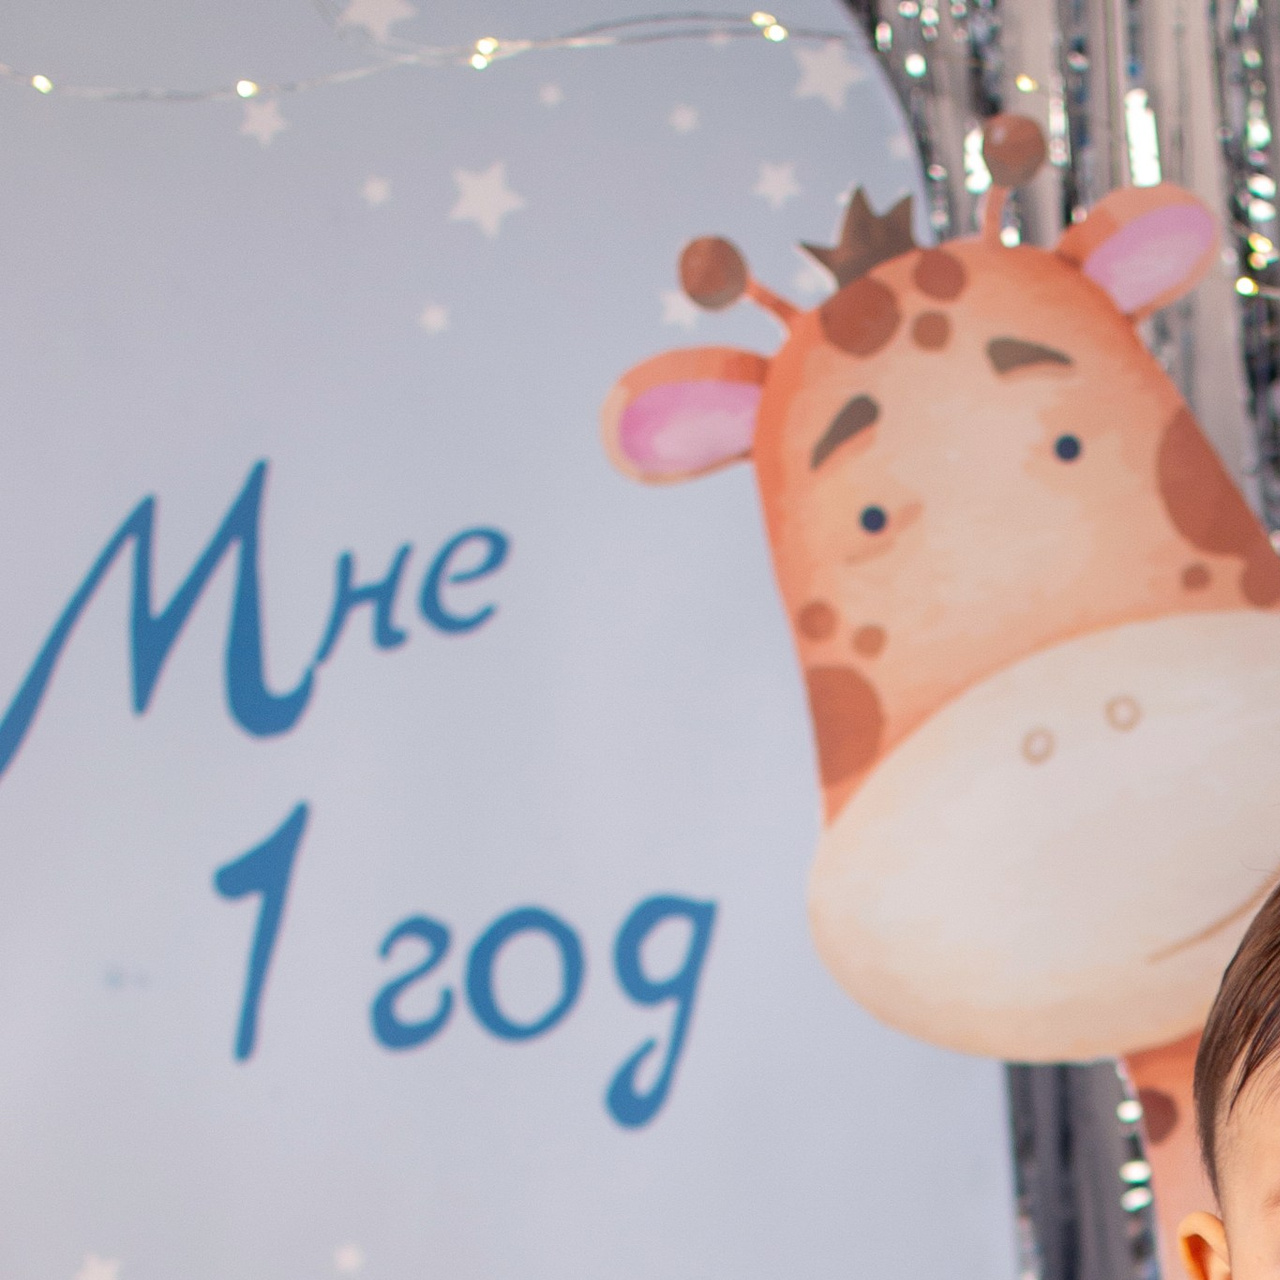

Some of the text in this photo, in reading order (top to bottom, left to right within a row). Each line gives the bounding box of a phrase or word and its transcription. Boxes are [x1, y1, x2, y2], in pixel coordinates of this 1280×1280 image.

[0, 458, 511, 776] Мне
[213, 800, 717, 1130] 1 год
